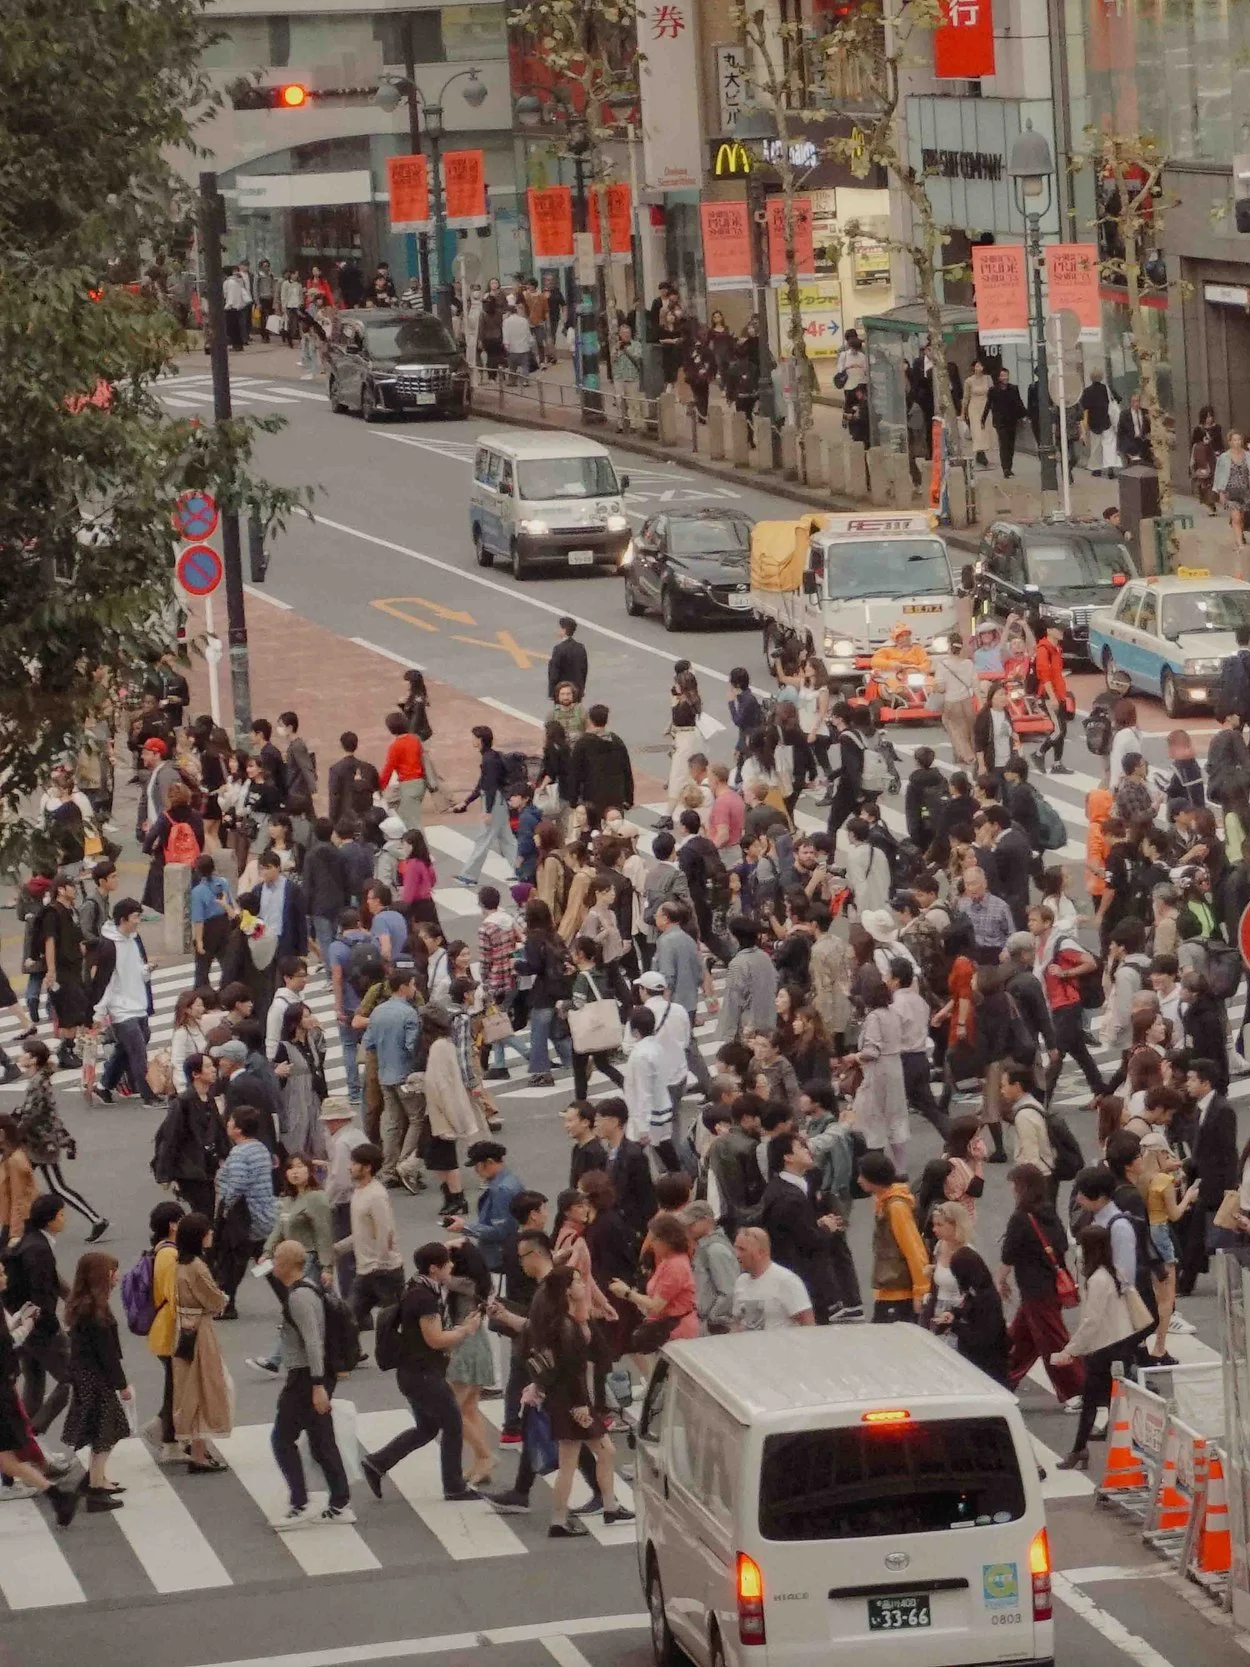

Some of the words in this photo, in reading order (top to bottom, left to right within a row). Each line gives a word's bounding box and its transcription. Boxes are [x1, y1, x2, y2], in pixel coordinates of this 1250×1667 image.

[651, 5, 686, 40] 券
[948, 0, 980, 27] 行
[981, 263, 1018, 275] PRIDE
[881, 1607, 929, 1627] 33-66
[991, 1613, 1023, 1626] 0803
